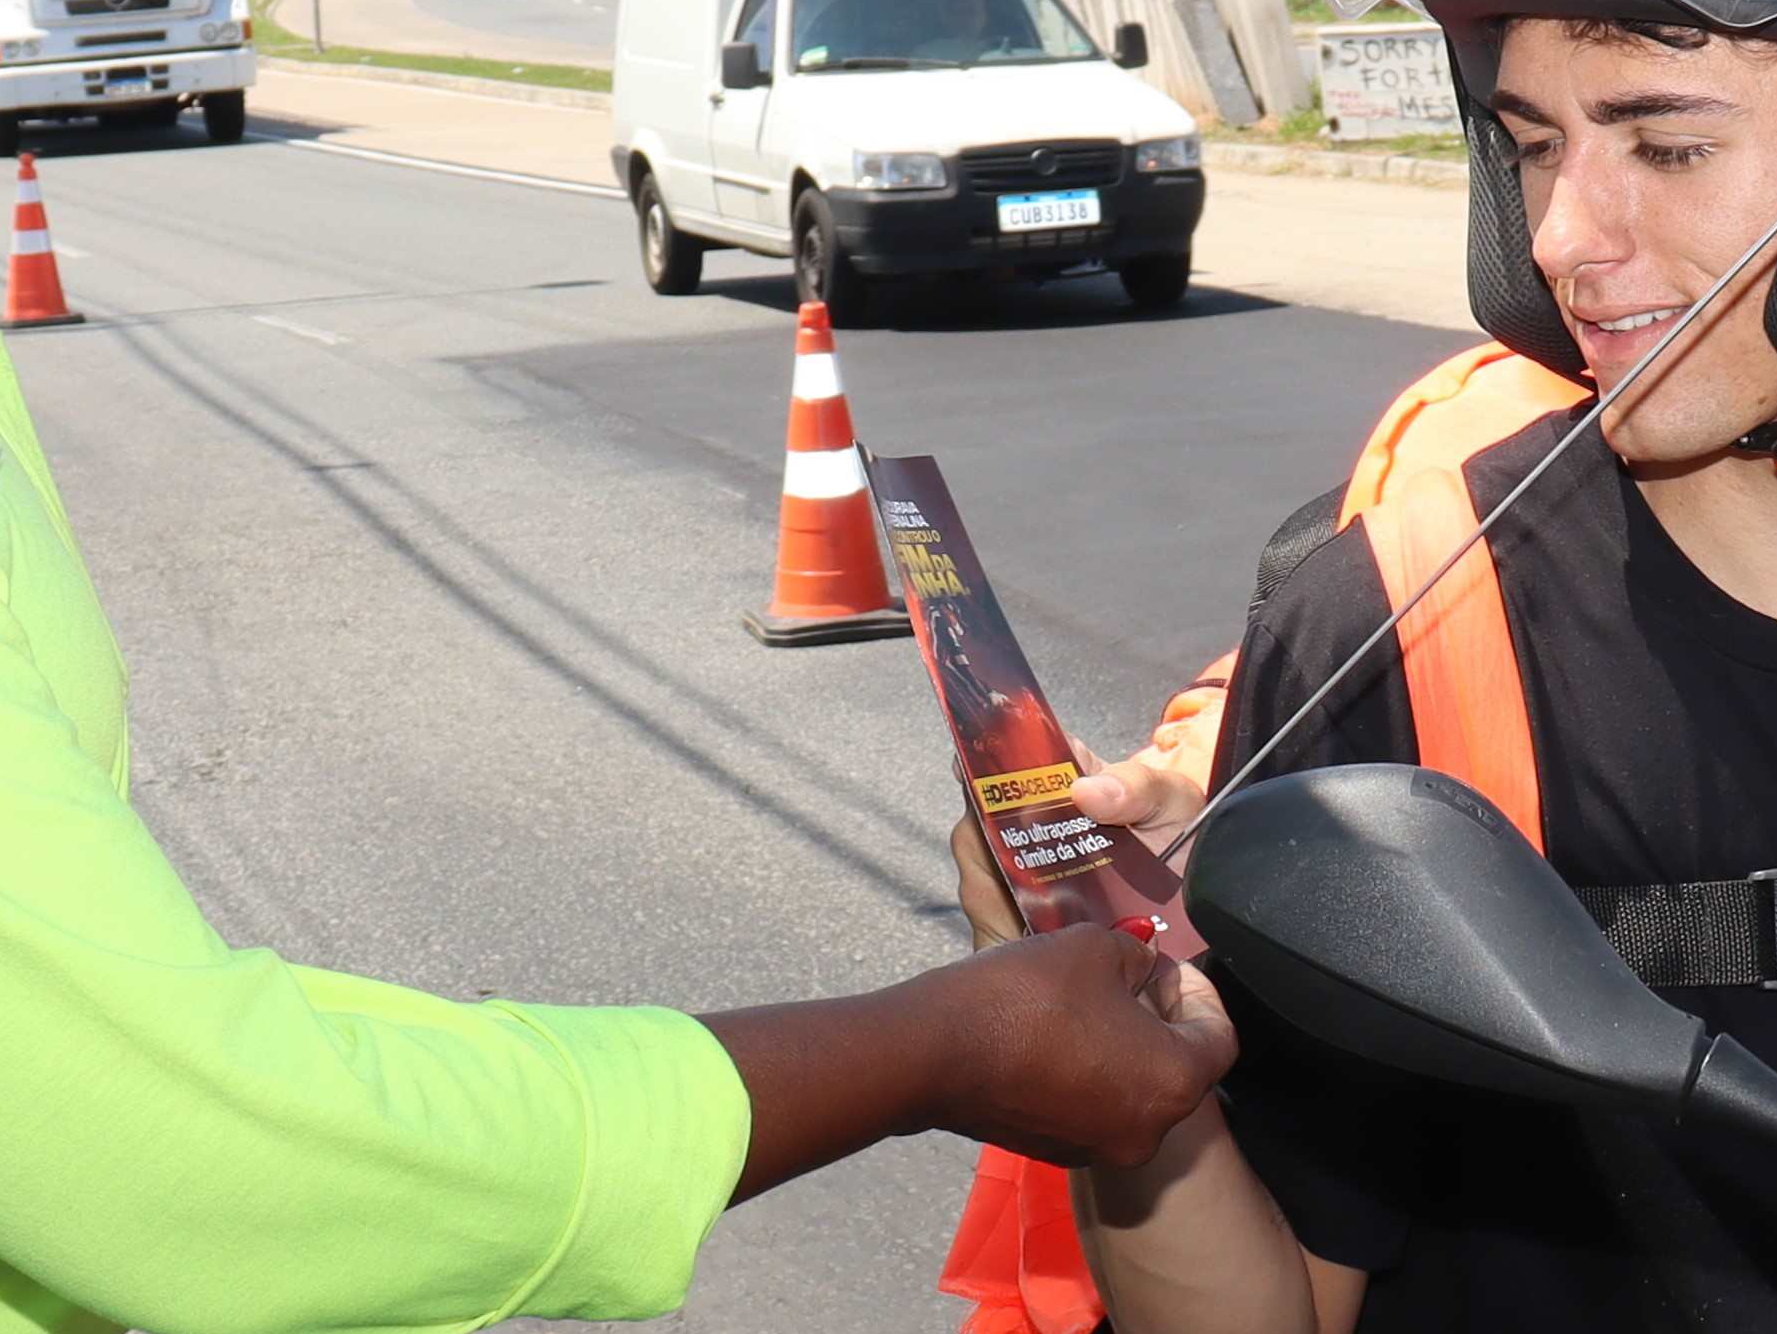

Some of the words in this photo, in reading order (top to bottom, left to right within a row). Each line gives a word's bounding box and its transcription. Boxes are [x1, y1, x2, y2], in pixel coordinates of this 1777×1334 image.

[1339, 36, 1441, 67] SORRY
[1360, 68, 1425, 90] FOR
[931, 553, 958, 571] DA
[909, 569, 972, 599] INHA.
[981, 772, 1074, 808] #DESACELERA
[1000, 827, 1030, 849] Não
[1029, 817, 1098, 843] ultrapasse
[1013, 855, 1025, 870] o
[1023, 846, 1058, 869] limite
[1056, 843, 1077, 862] da
[1074, 832, 1114, 856] vida.
